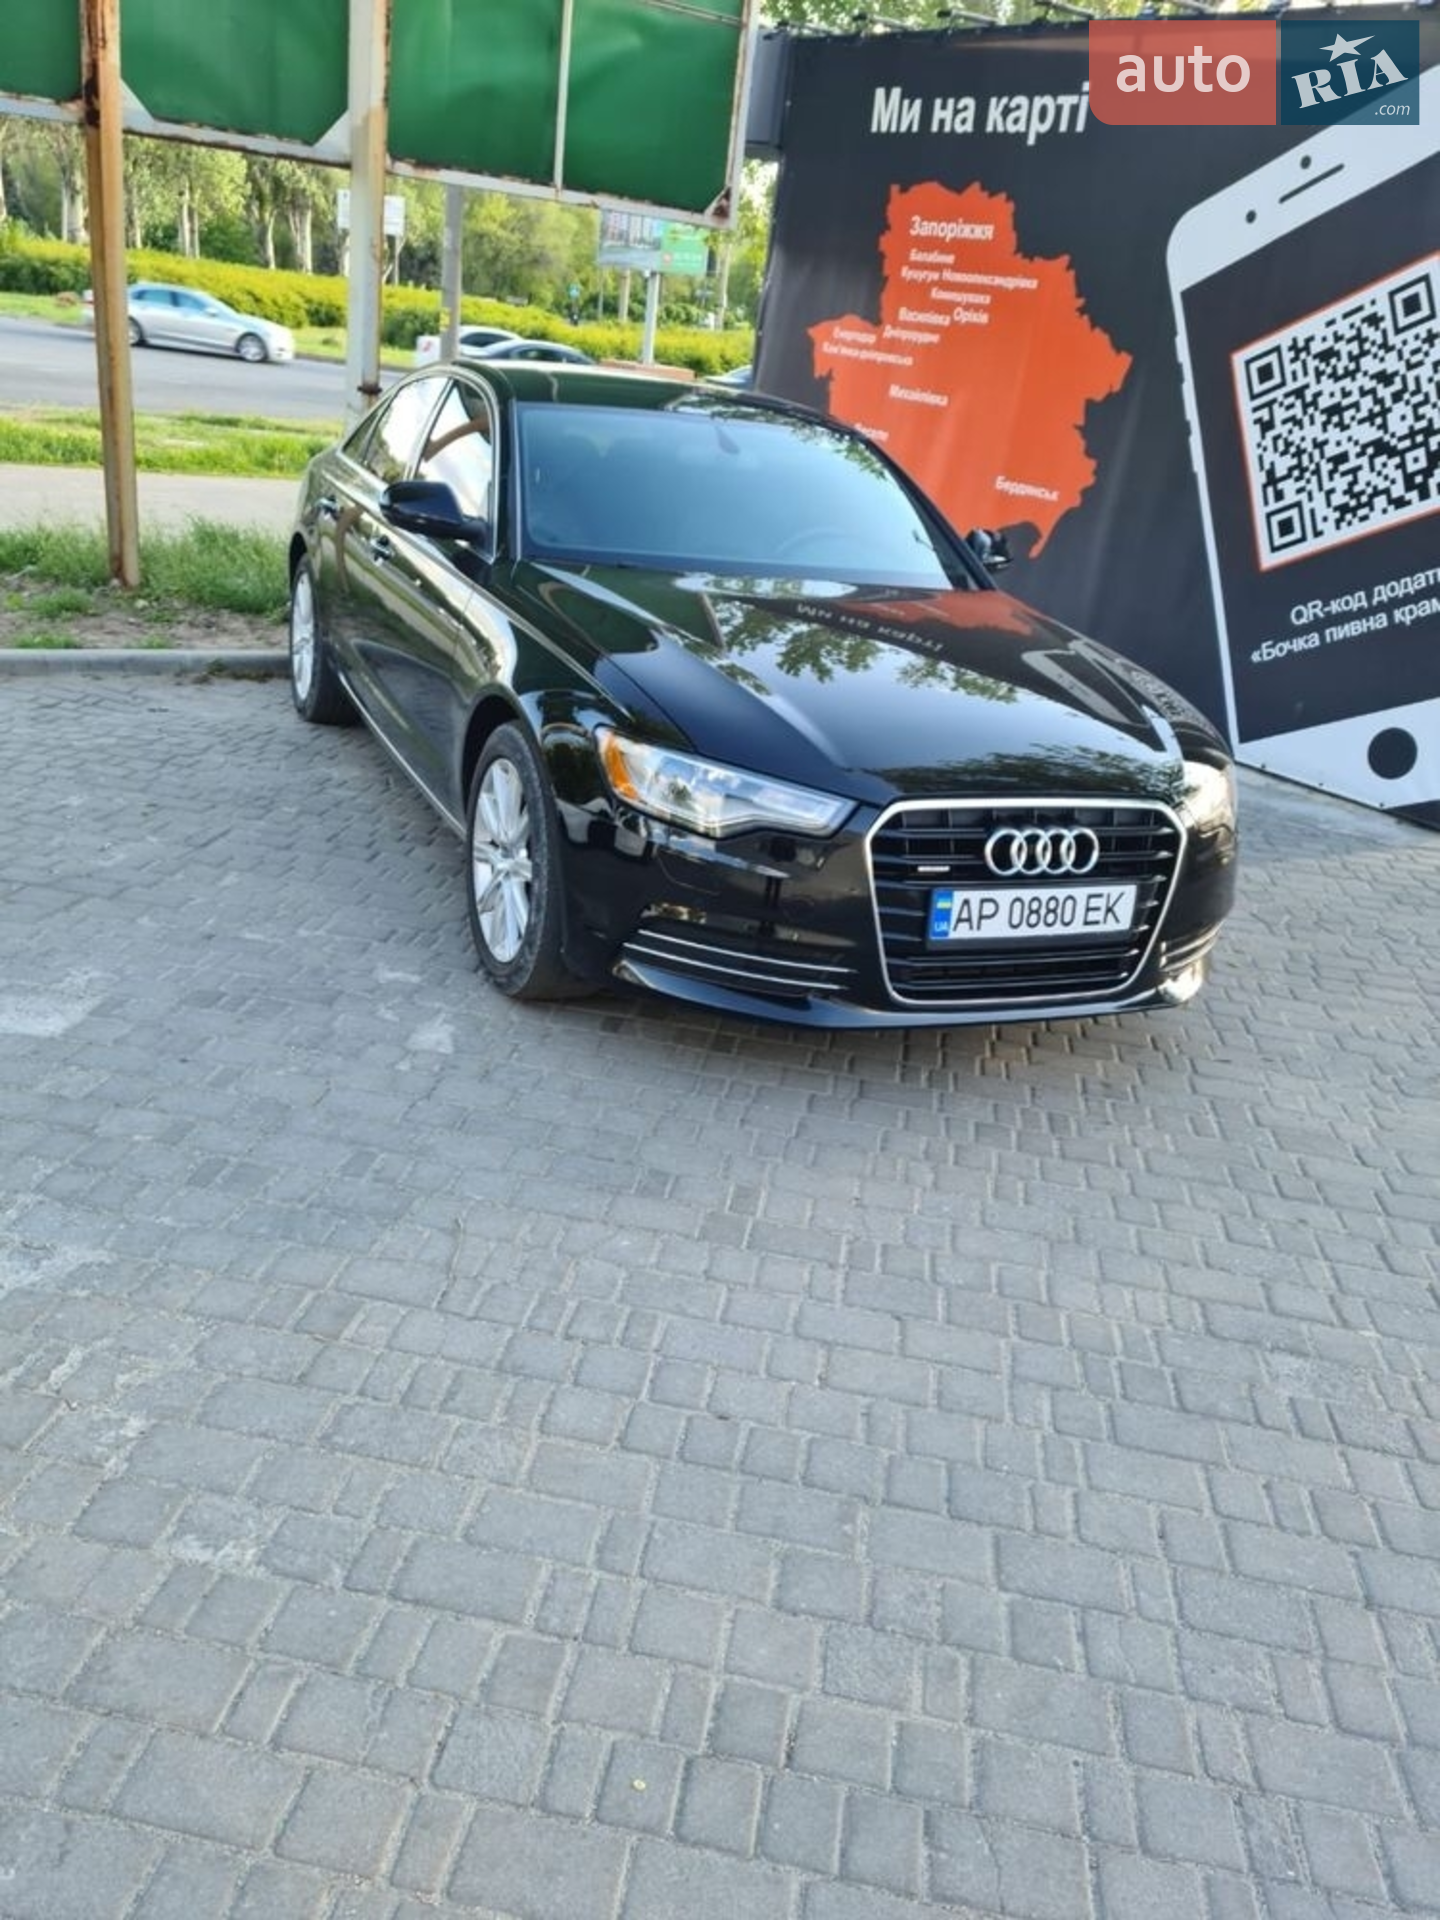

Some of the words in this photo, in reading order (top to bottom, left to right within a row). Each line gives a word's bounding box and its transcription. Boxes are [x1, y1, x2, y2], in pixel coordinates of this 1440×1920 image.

[871, 87, 922, 133] Ми
[930, 96, 976, 134] на
[985, 81, 1090, 146] карті
[909, 214, 994, 242] Запоріжжя
[1290, 590, 1368, 626] QR-код
[1250, 632, 1321, 663] «Бочка
[1325, 612, 1388, 643] пивна
[952, 897, 999, 931] AP
[1008, 894, 1077, 930] 0880
[1082, 892, 1125, 926] EK
